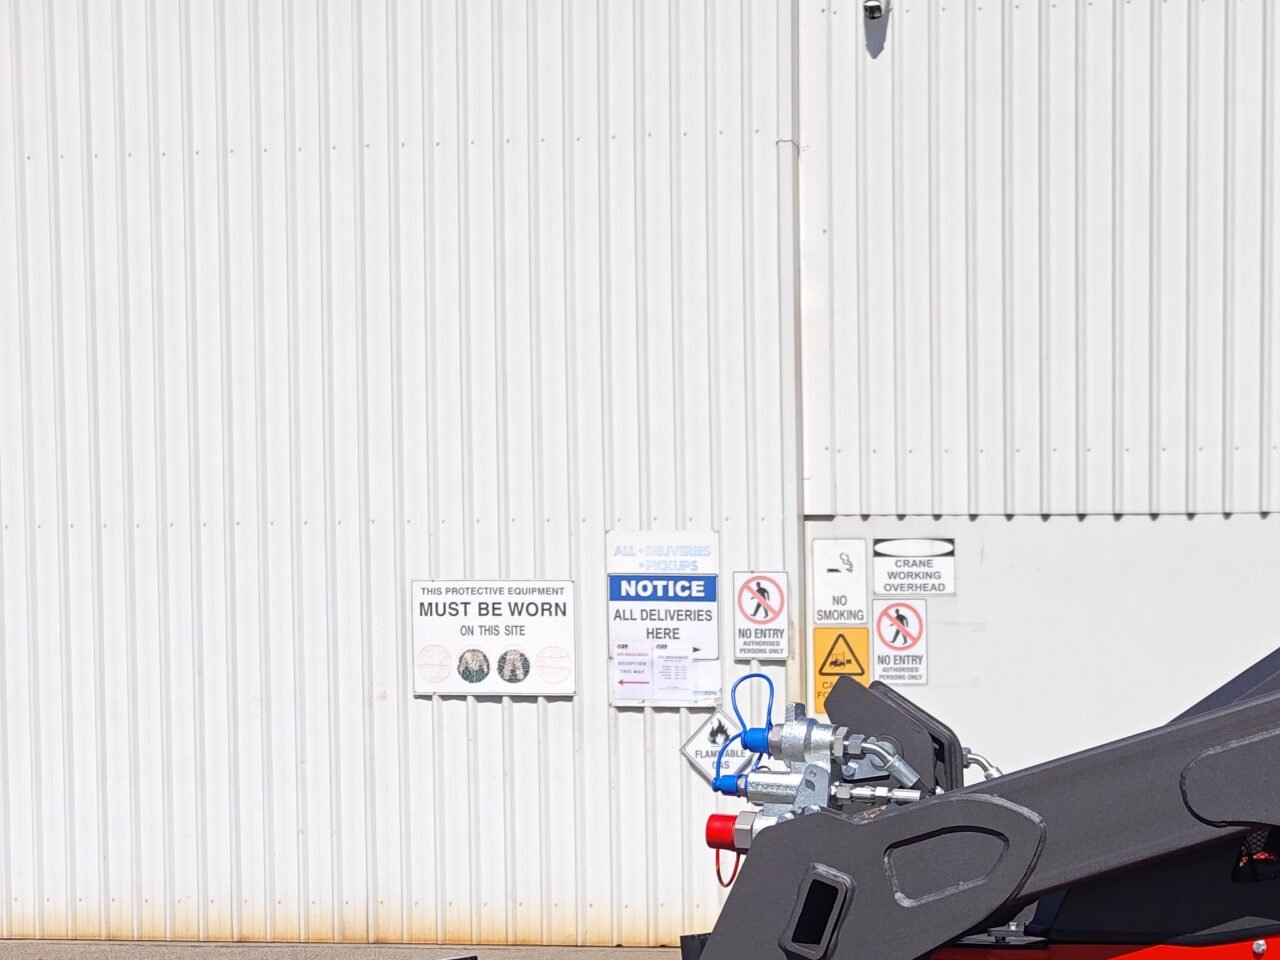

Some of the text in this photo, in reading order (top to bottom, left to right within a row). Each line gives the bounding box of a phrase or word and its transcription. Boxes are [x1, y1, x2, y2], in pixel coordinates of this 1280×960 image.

[613, 545, 636, 556] ALL
[895, 559, 933, 568] CRANE
[887, 571, 942, 580] WORKING
[421, 587, 565, 596] THIS PROTECTIVE EQUIPMENT
[620, 580, 705, 597] NOTICE
[883, 583, 946, 592] OVERHEAD
[832, 595, 848, 606] NO
[419, 602, 567, 617] MUST BE WORN
[816, 609, 864, 621] SMOKING
[613, 609, 713, 622] ALL DELIVERIES
[460, 625, 526, 636] ON THIS SITE
[646, 627, 680, 640] HERE
[738, 628, 785, 639] NO ENTRY
[877, 655, 923, 666] NO ENTRY
[695, 750, 746, 759] FLAMABLE
